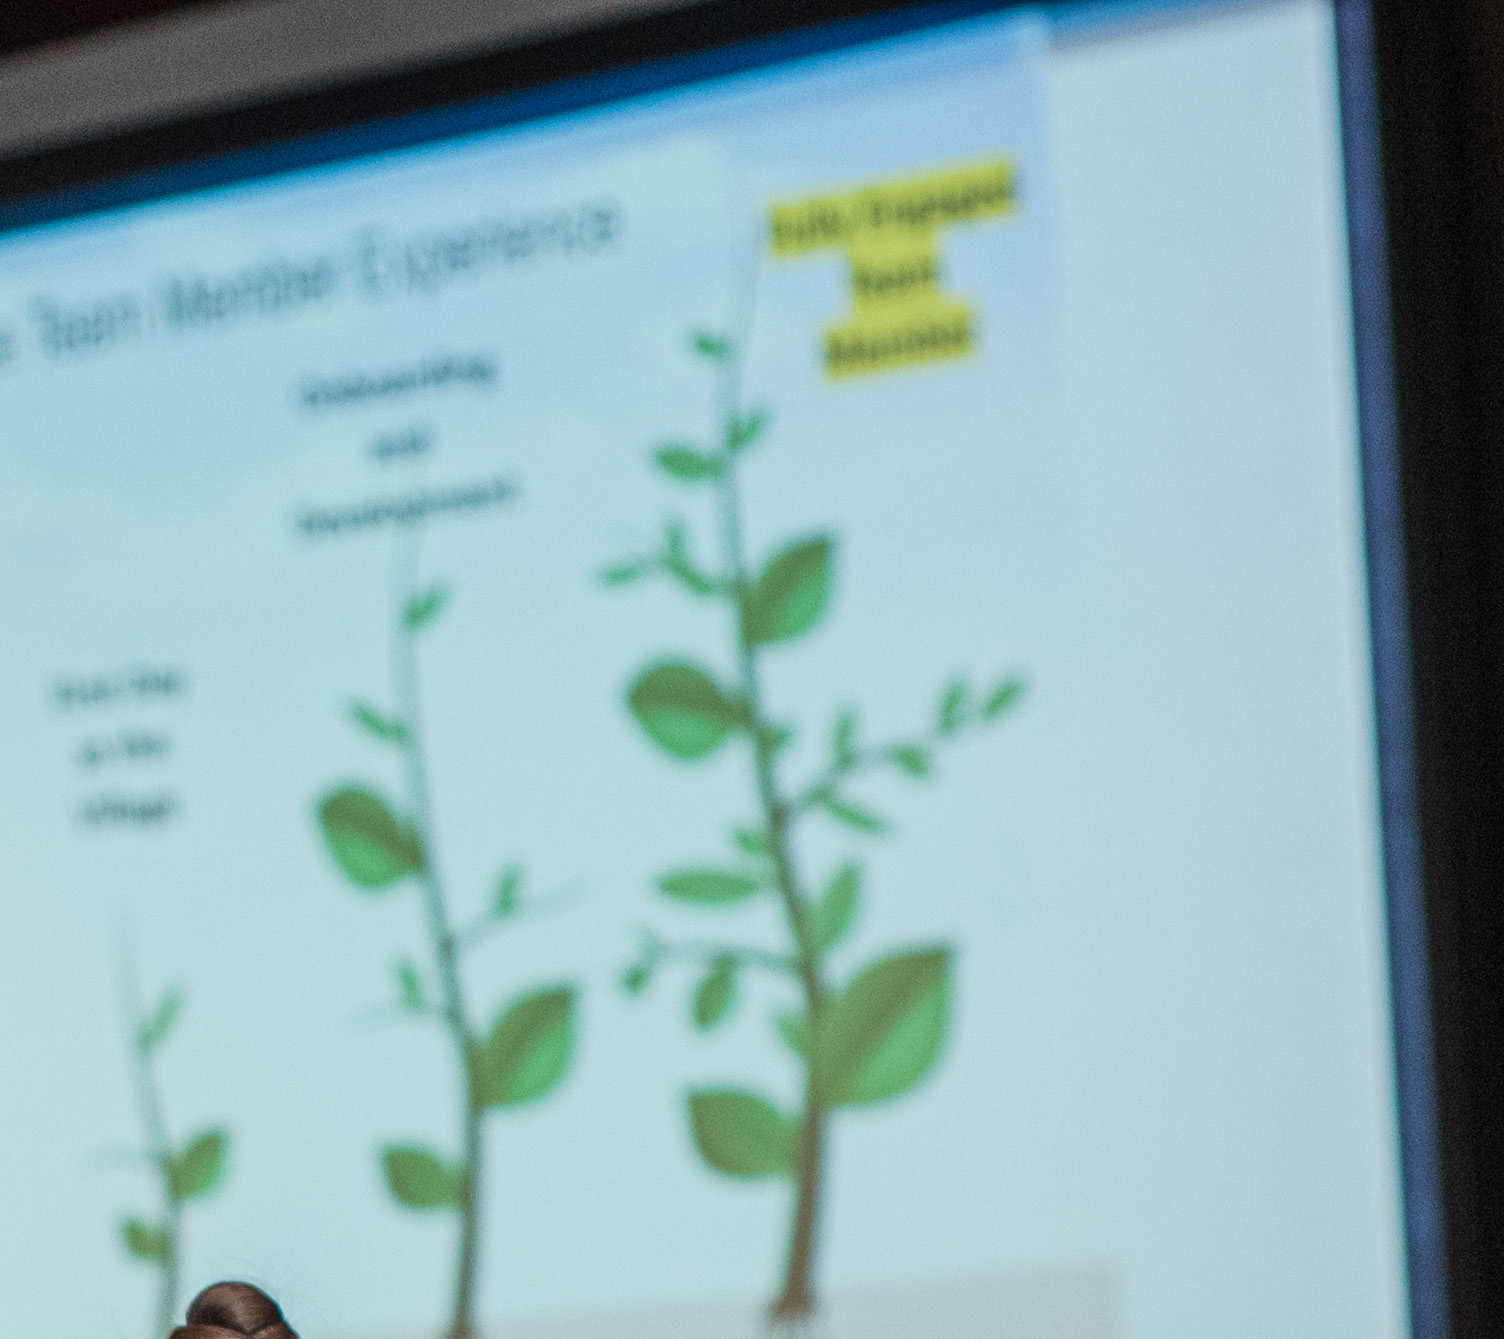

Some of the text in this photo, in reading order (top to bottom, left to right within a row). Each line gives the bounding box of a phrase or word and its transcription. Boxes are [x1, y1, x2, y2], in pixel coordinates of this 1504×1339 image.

[27, 287, 142, 364] Team
[159, 253, 336, 333] Member
[353, 205, 625, 301] Experience
[294, 482, 519, 533] Development
